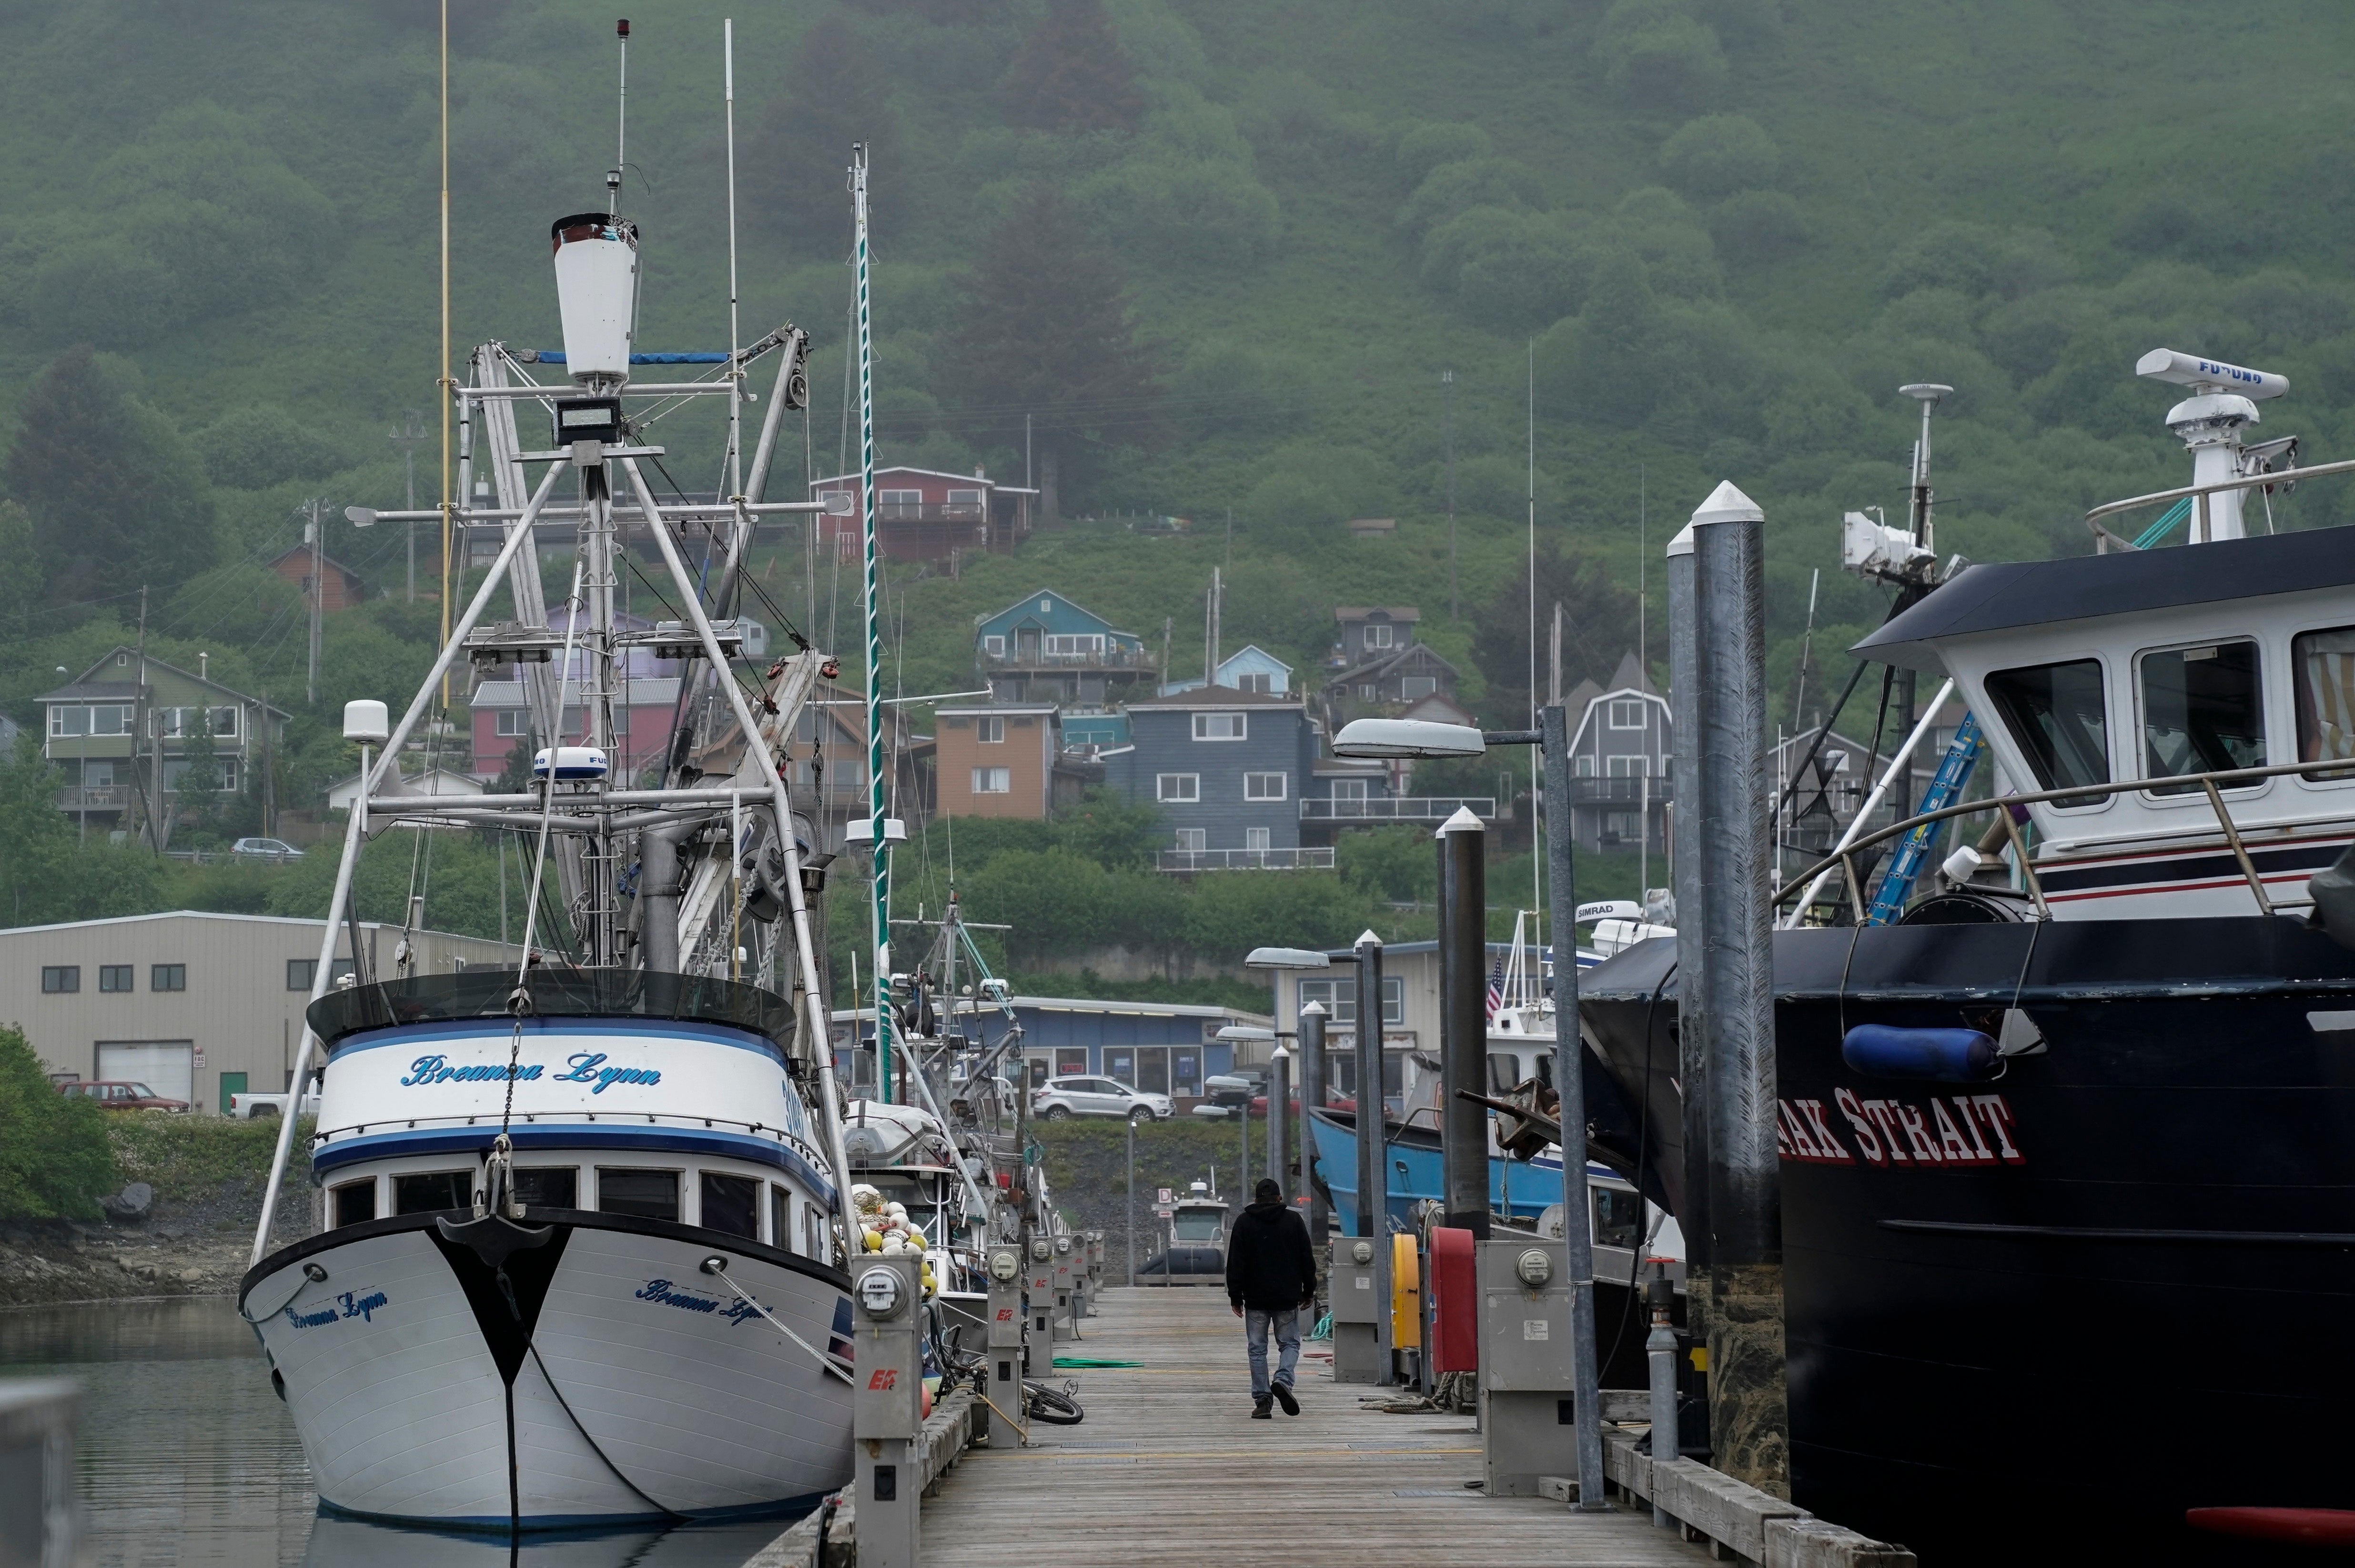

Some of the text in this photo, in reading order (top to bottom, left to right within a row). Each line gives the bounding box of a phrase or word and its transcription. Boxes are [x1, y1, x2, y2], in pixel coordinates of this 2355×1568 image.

[1578, 905, 1614, 917] SIMRAD
[400, 1052, 661, 1094] Breanna Lynn
[1835, 1086, 2026, 1168] STRAIT
[1160, 1189, 1171, 1202] D
[337, 1291, 388, 1323] Lynn
[635, 1278, 720, 1313] Breanna
